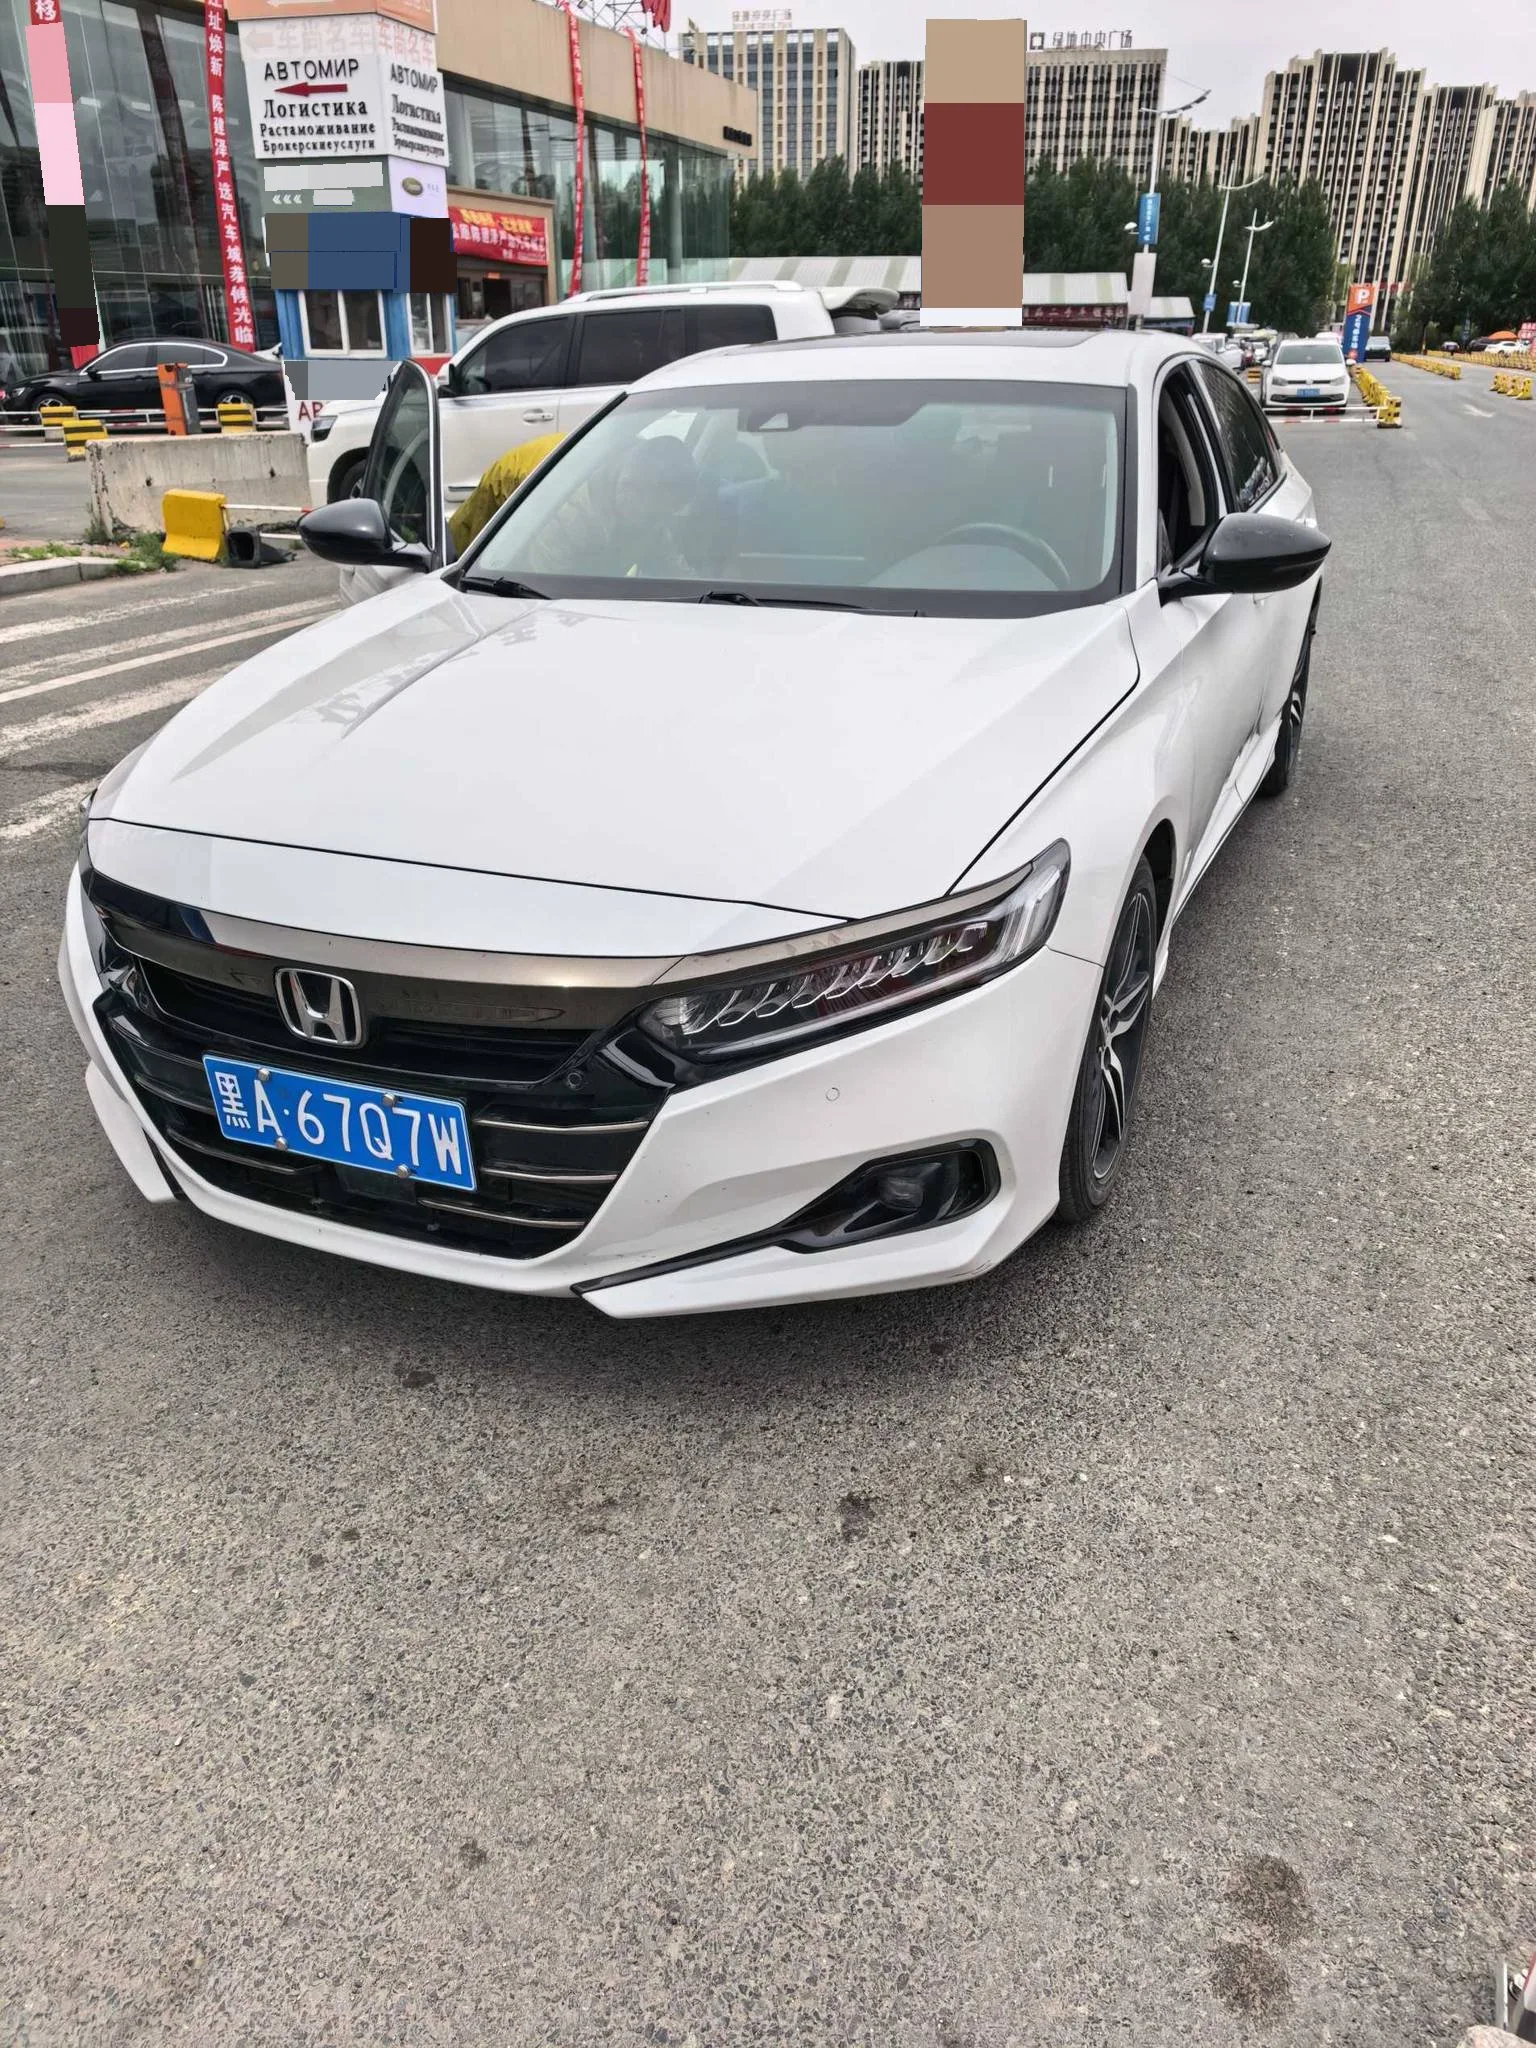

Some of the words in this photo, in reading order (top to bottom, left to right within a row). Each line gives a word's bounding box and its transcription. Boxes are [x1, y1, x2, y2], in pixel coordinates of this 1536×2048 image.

[264, 58, 359, 81] АВТОМИР
[390, 63, 438, 93] АВТОМИР
[264, 99, 368, 119] Логистика
[260, 122, 375, 138] Растаможивание
[1355, 289, 1370, 304] P
